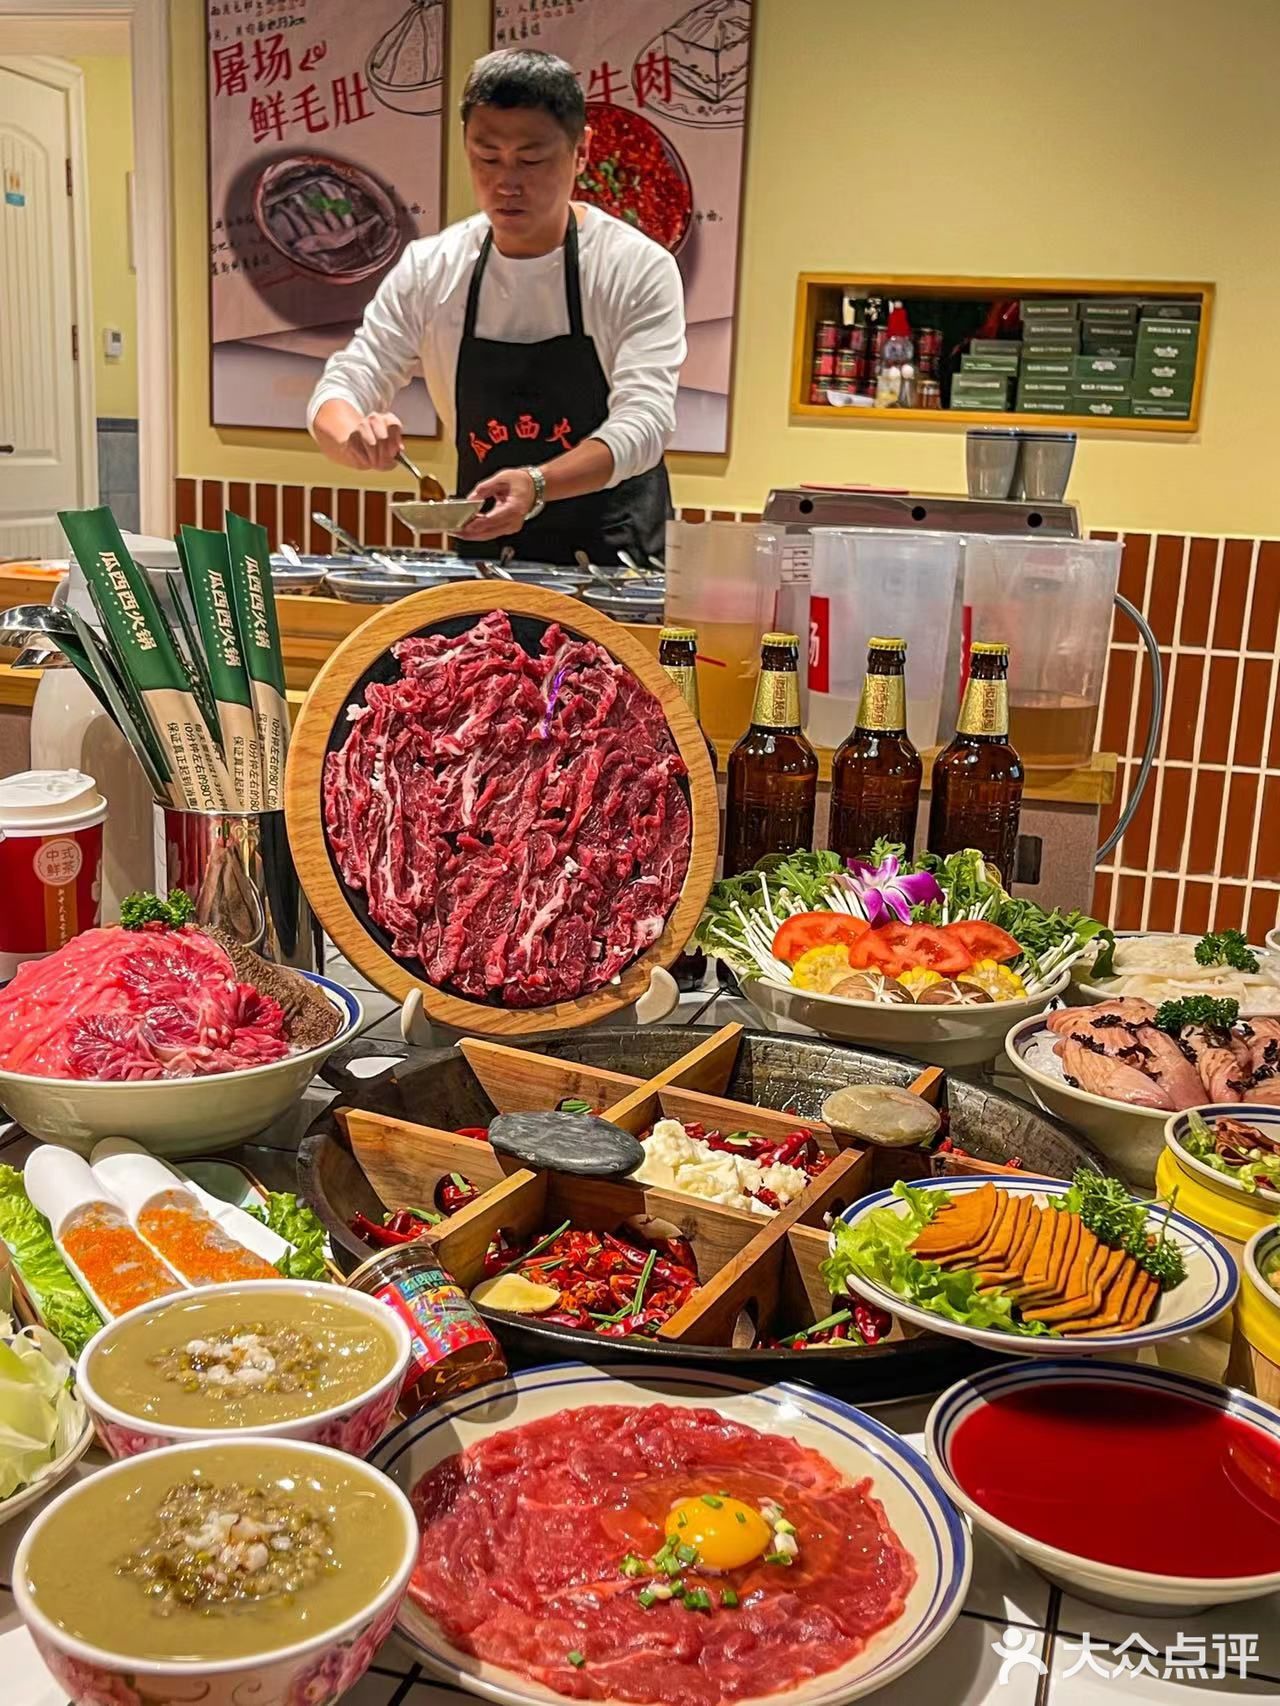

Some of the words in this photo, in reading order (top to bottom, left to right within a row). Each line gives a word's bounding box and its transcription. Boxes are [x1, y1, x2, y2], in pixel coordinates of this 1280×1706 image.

[212, 33, 292, 97] 屠场
[575, 50, 673, 108] 牛肉
[249, 72, 375, 144] 鲜毛肚
[98, 551, 158, 651] 瓜西西火锅
[207, 568, 242, 667] 瓜西西火锅
[244, 554, 271, 649] 瓜西西火锅
[46, 847, 75, 862] 中式
